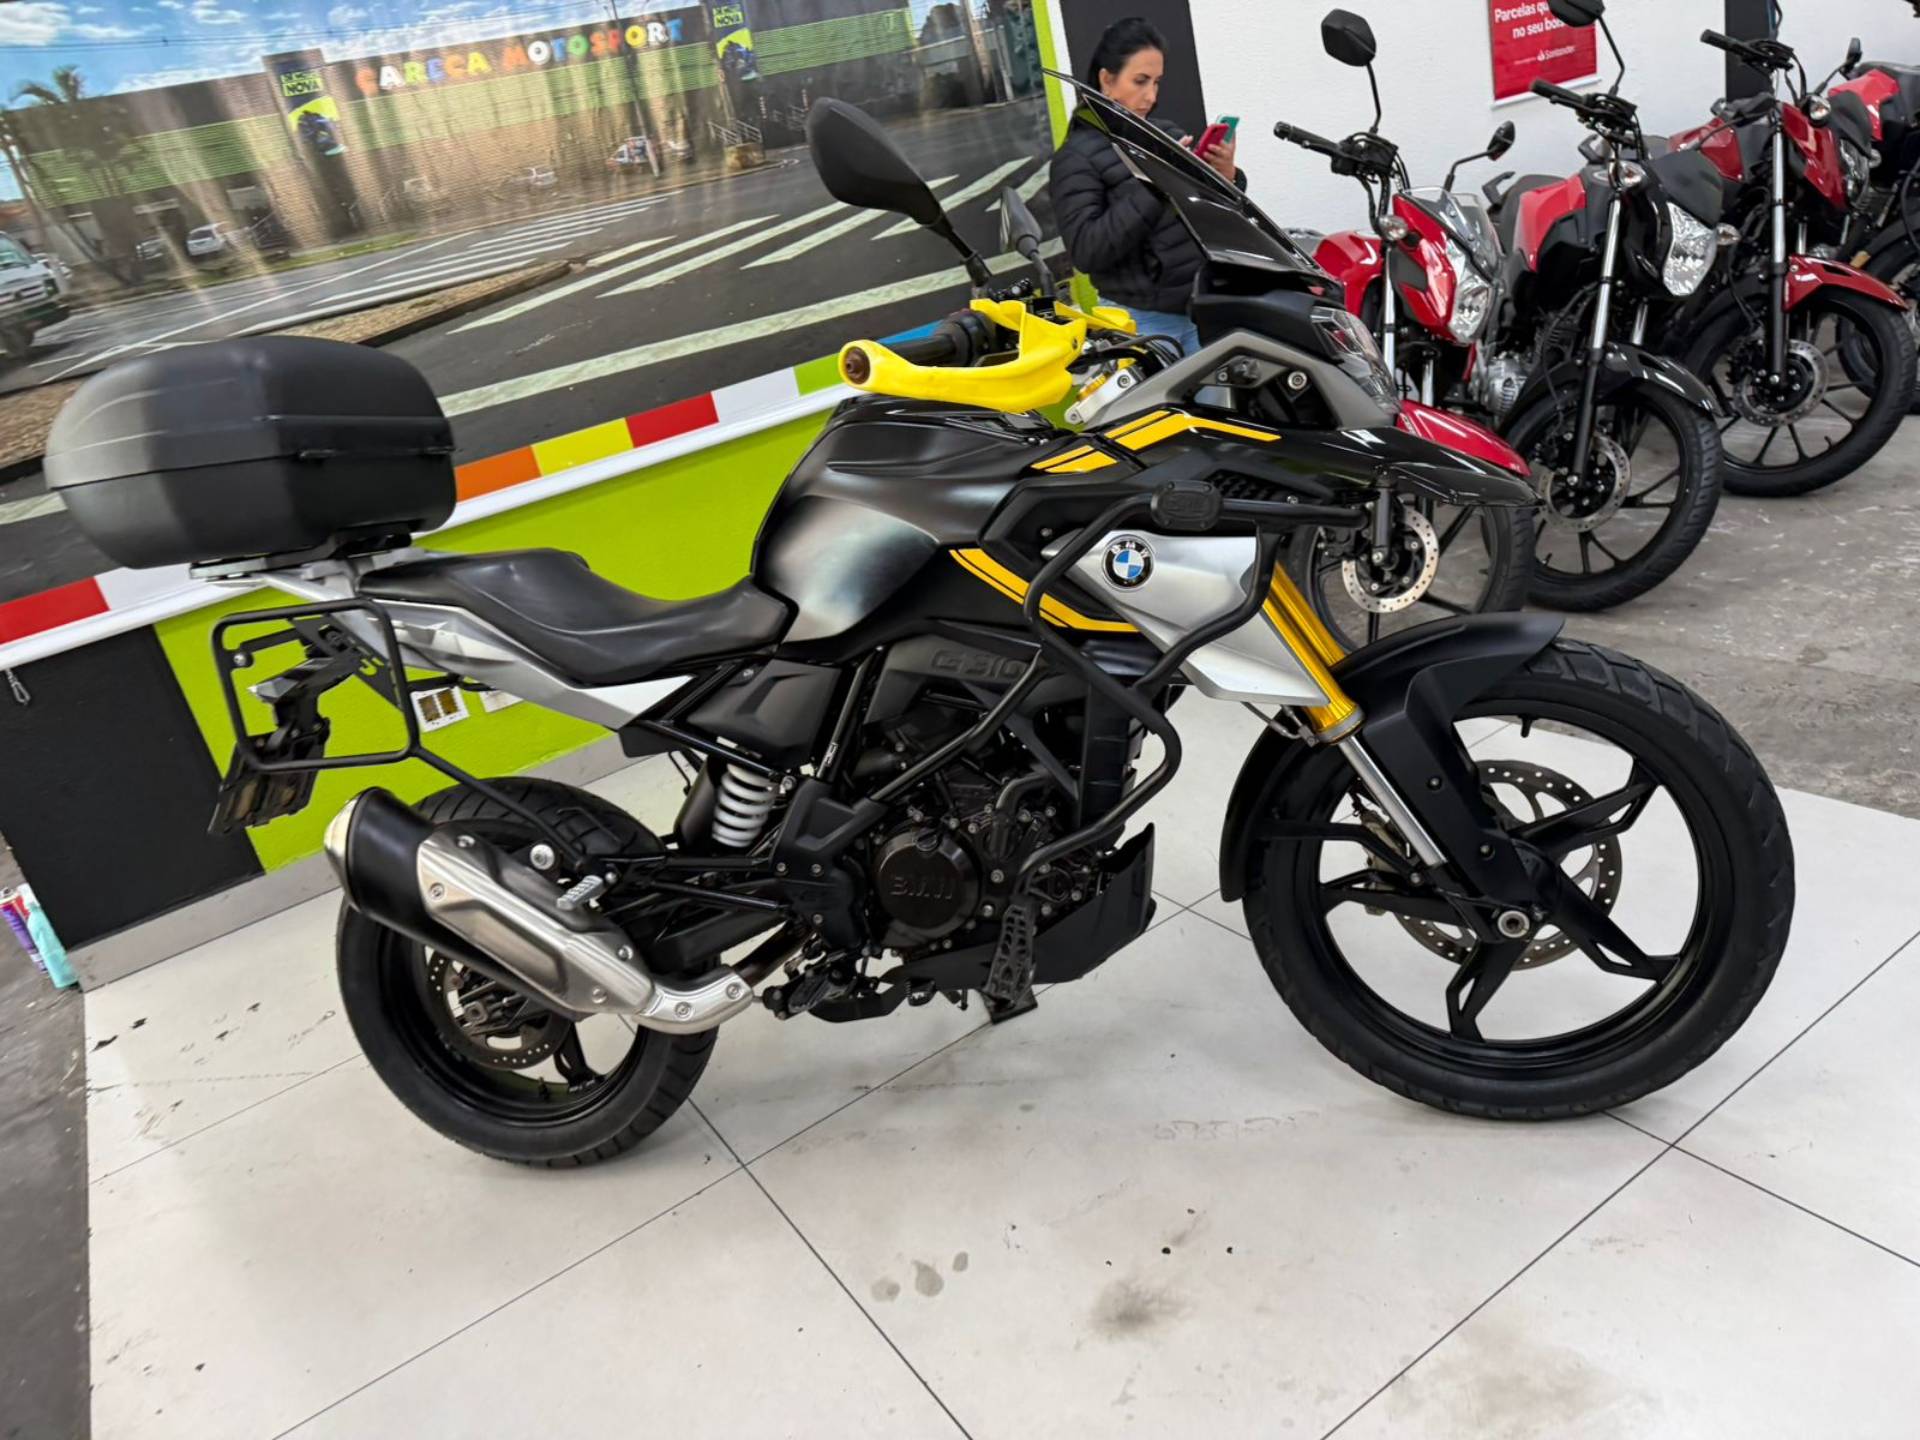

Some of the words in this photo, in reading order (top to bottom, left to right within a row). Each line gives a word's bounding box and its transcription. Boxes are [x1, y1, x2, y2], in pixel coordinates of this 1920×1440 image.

[1495, 3, 1536, 23] Parcelas
[1537, 1, 1549, 16] qu
[1513, 27, 1525, 38] no
[1527, 23, 1543, 35] seu
[355, 51, 492, 96] CARECA
[502, 18, 682, 72] MOTOSPORT
[1110, 541, 1150, 558] BMW
